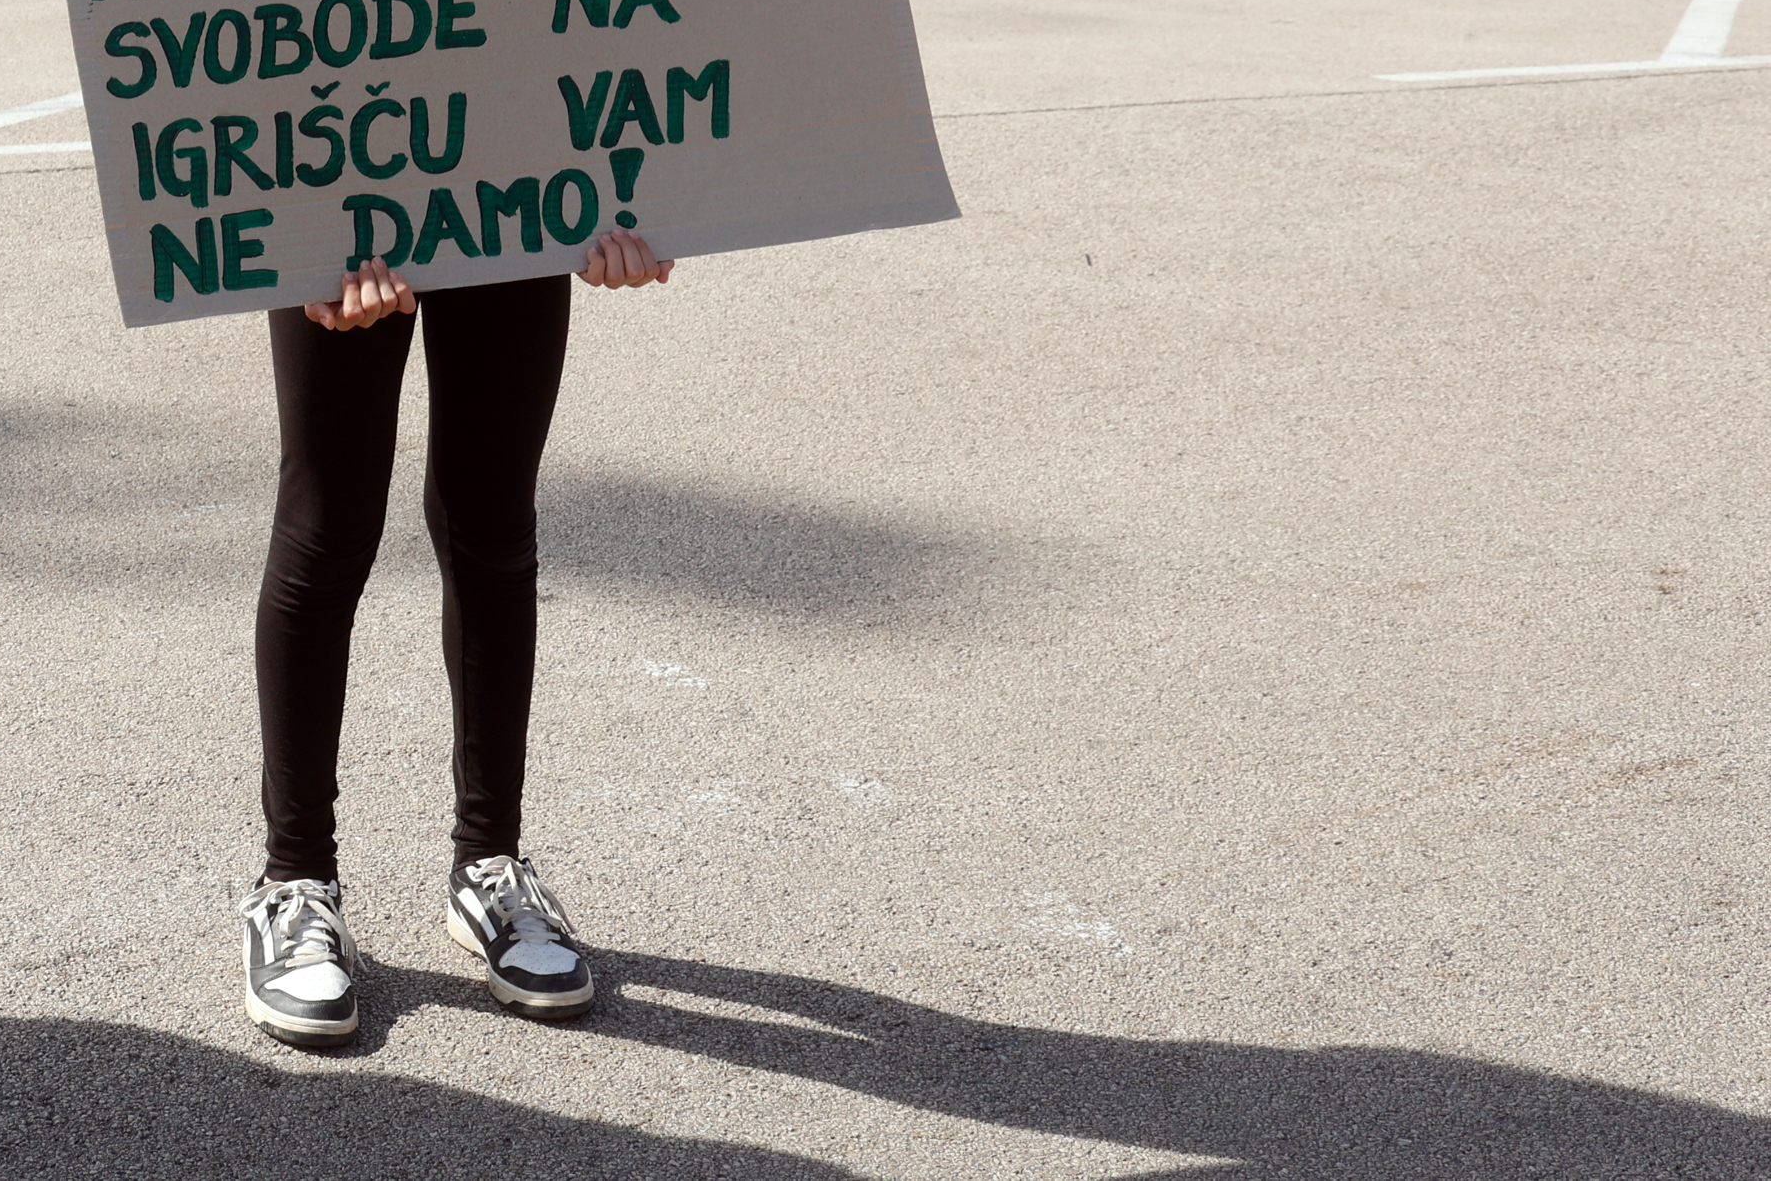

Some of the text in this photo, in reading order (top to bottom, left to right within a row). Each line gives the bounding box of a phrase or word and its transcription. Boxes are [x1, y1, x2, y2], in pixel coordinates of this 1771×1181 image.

[132, 60, 729, 208] IGRIŠČU VAM
[150, 148, 645, 302] NE DAMO!
